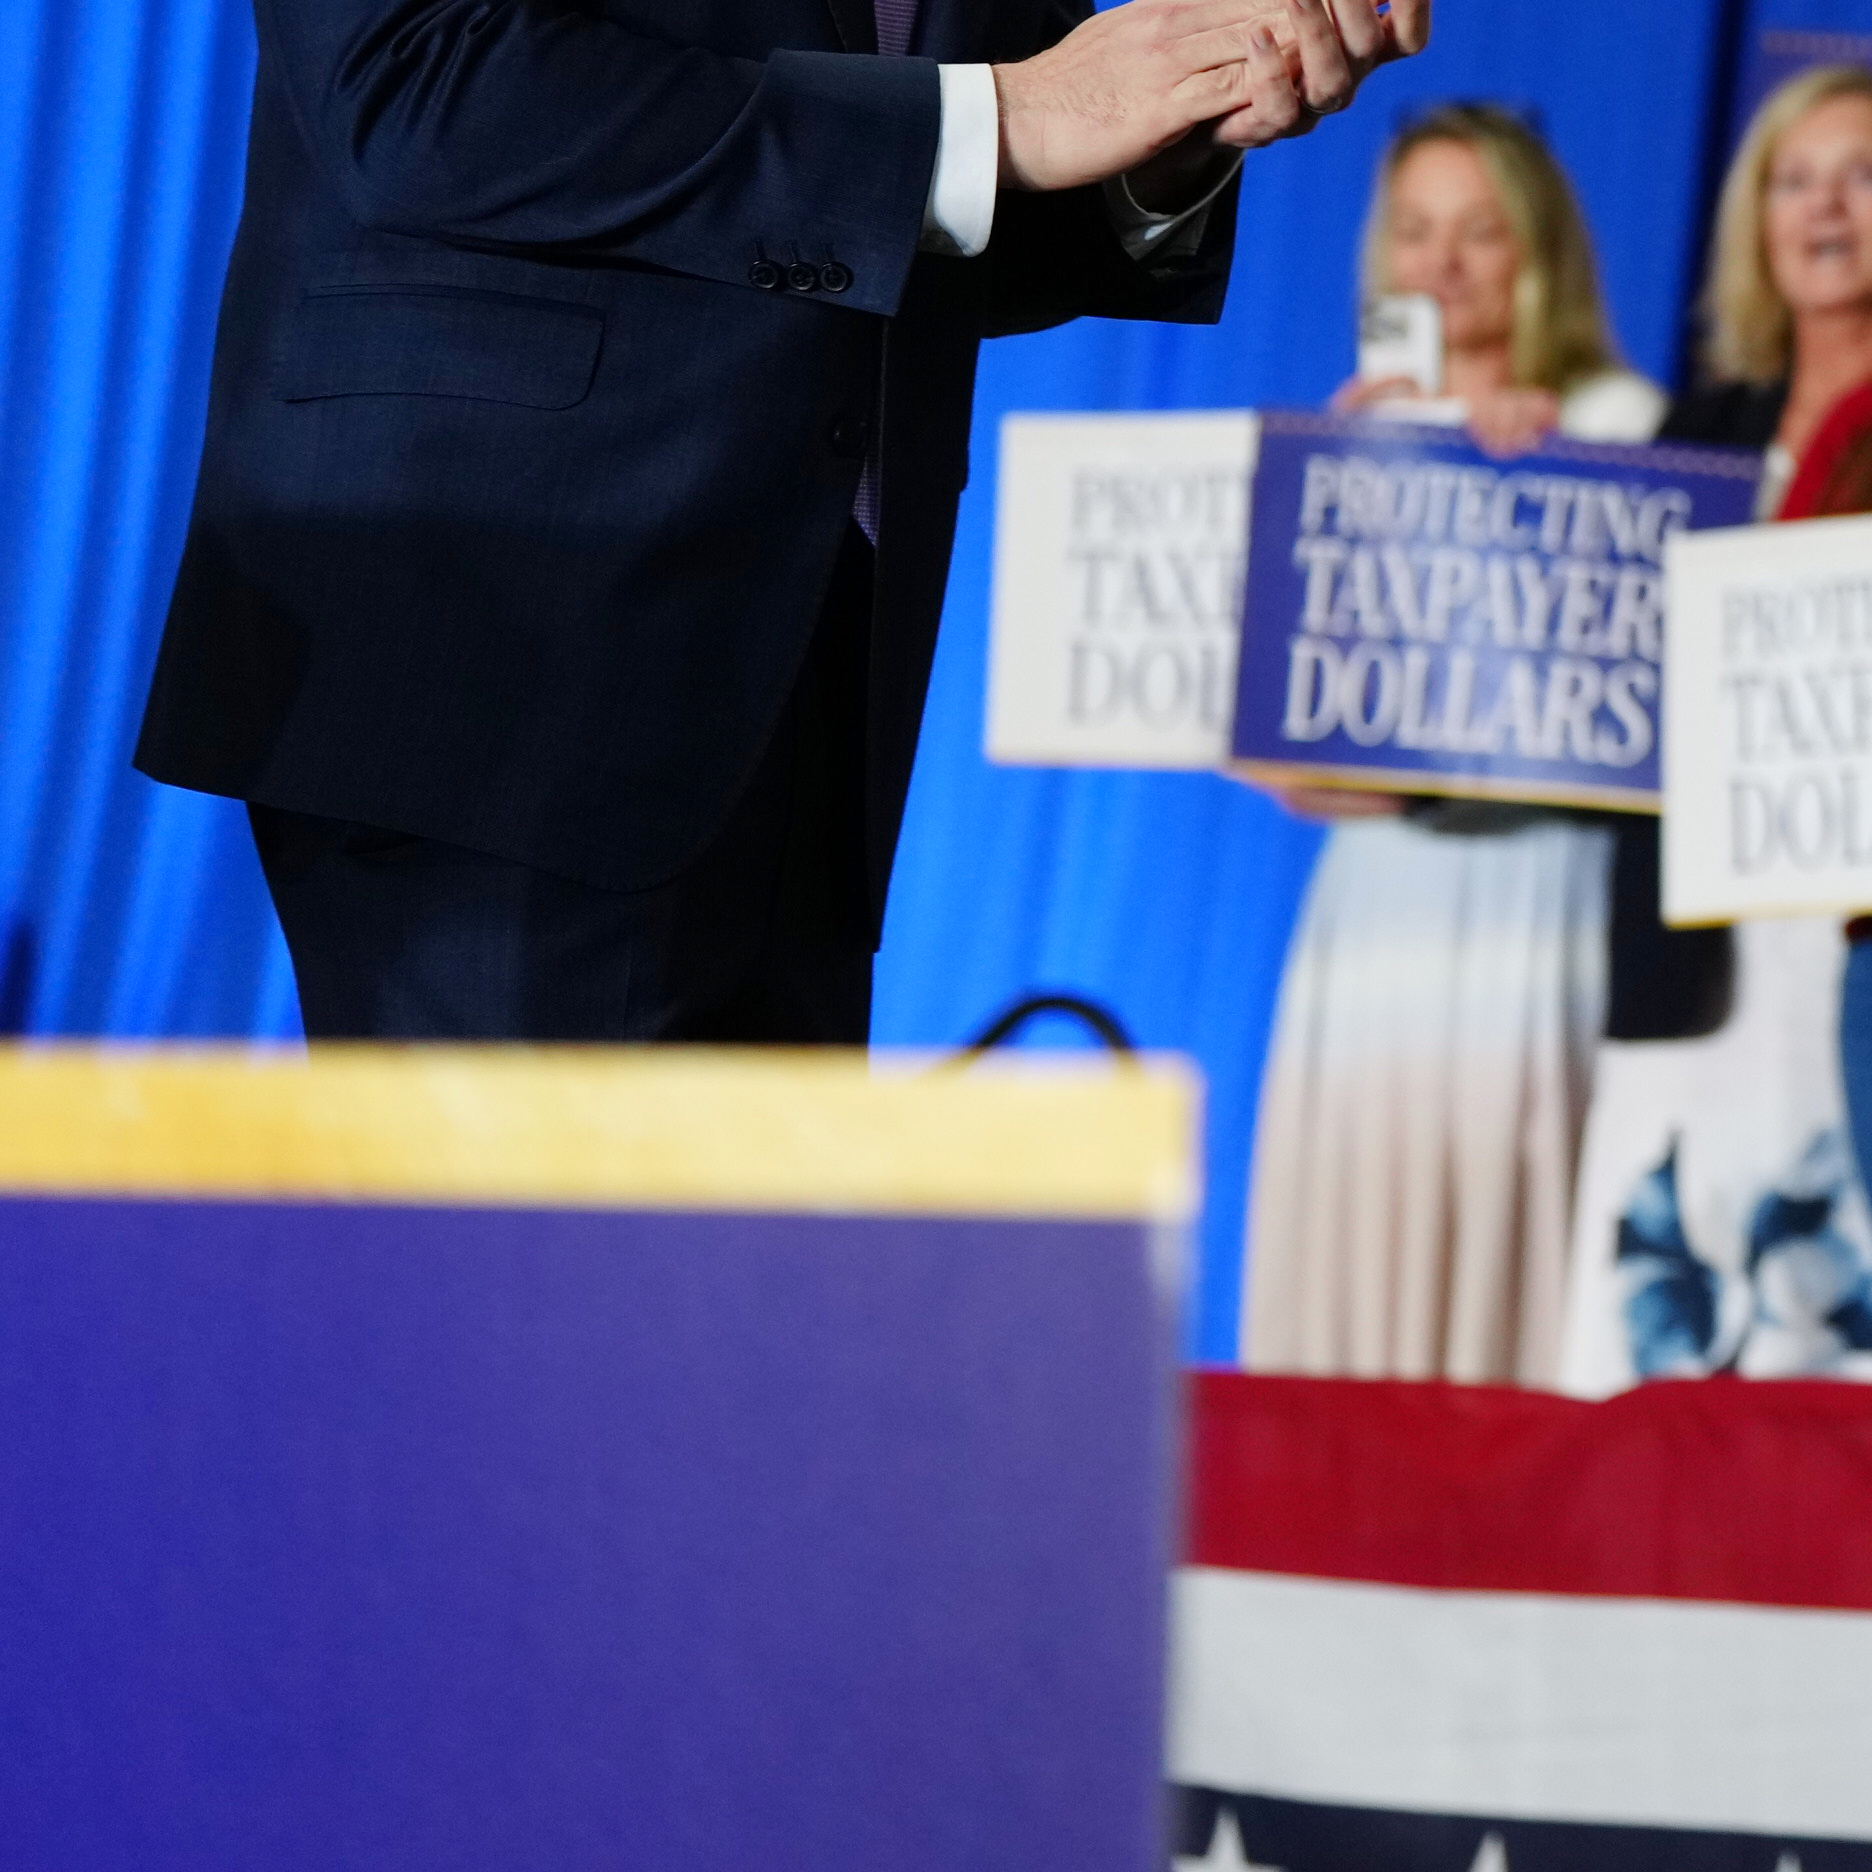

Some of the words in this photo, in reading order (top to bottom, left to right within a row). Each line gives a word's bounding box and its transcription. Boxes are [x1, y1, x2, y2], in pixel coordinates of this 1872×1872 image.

[1298, 454, 1694, 565] PROTECTING
[1294, 536, 1668, 663] TAXPAYER
[1282, 636, 1660, 766] DOLLARS
